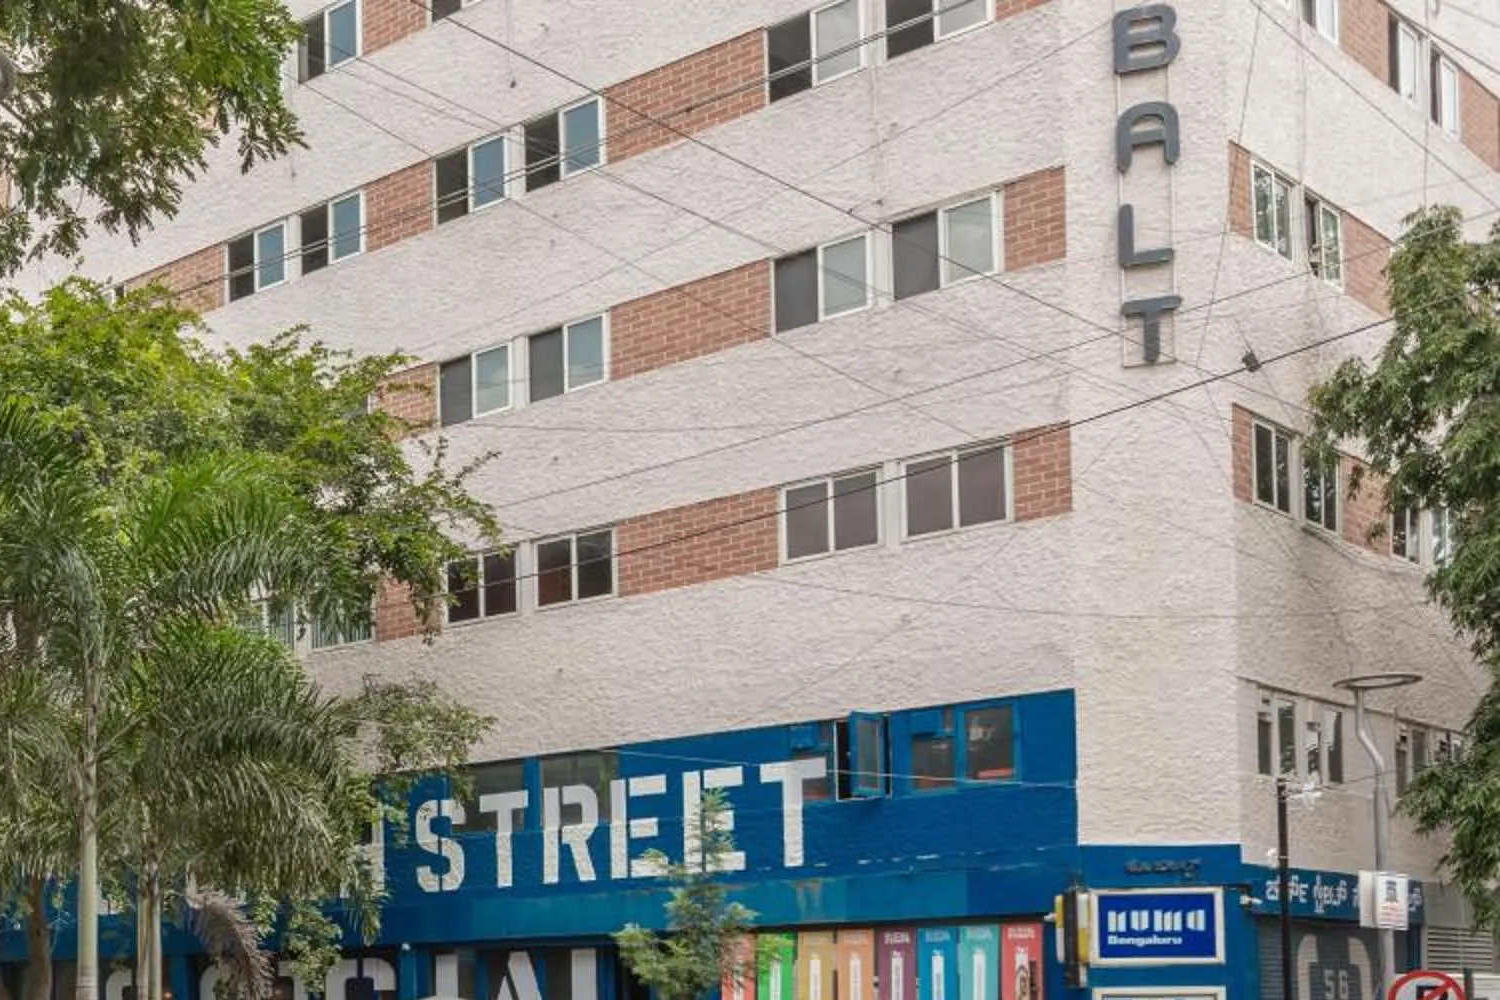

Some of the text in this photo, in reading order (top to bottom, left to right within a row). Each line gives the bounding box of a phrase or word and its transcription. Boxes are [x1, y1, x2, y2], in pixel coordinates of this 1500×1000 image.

[1112, 3, 1183, 364] BALT
[415, 758, 827, 893] STREET
[1106, 933, 1183, 948] Bengaluru
